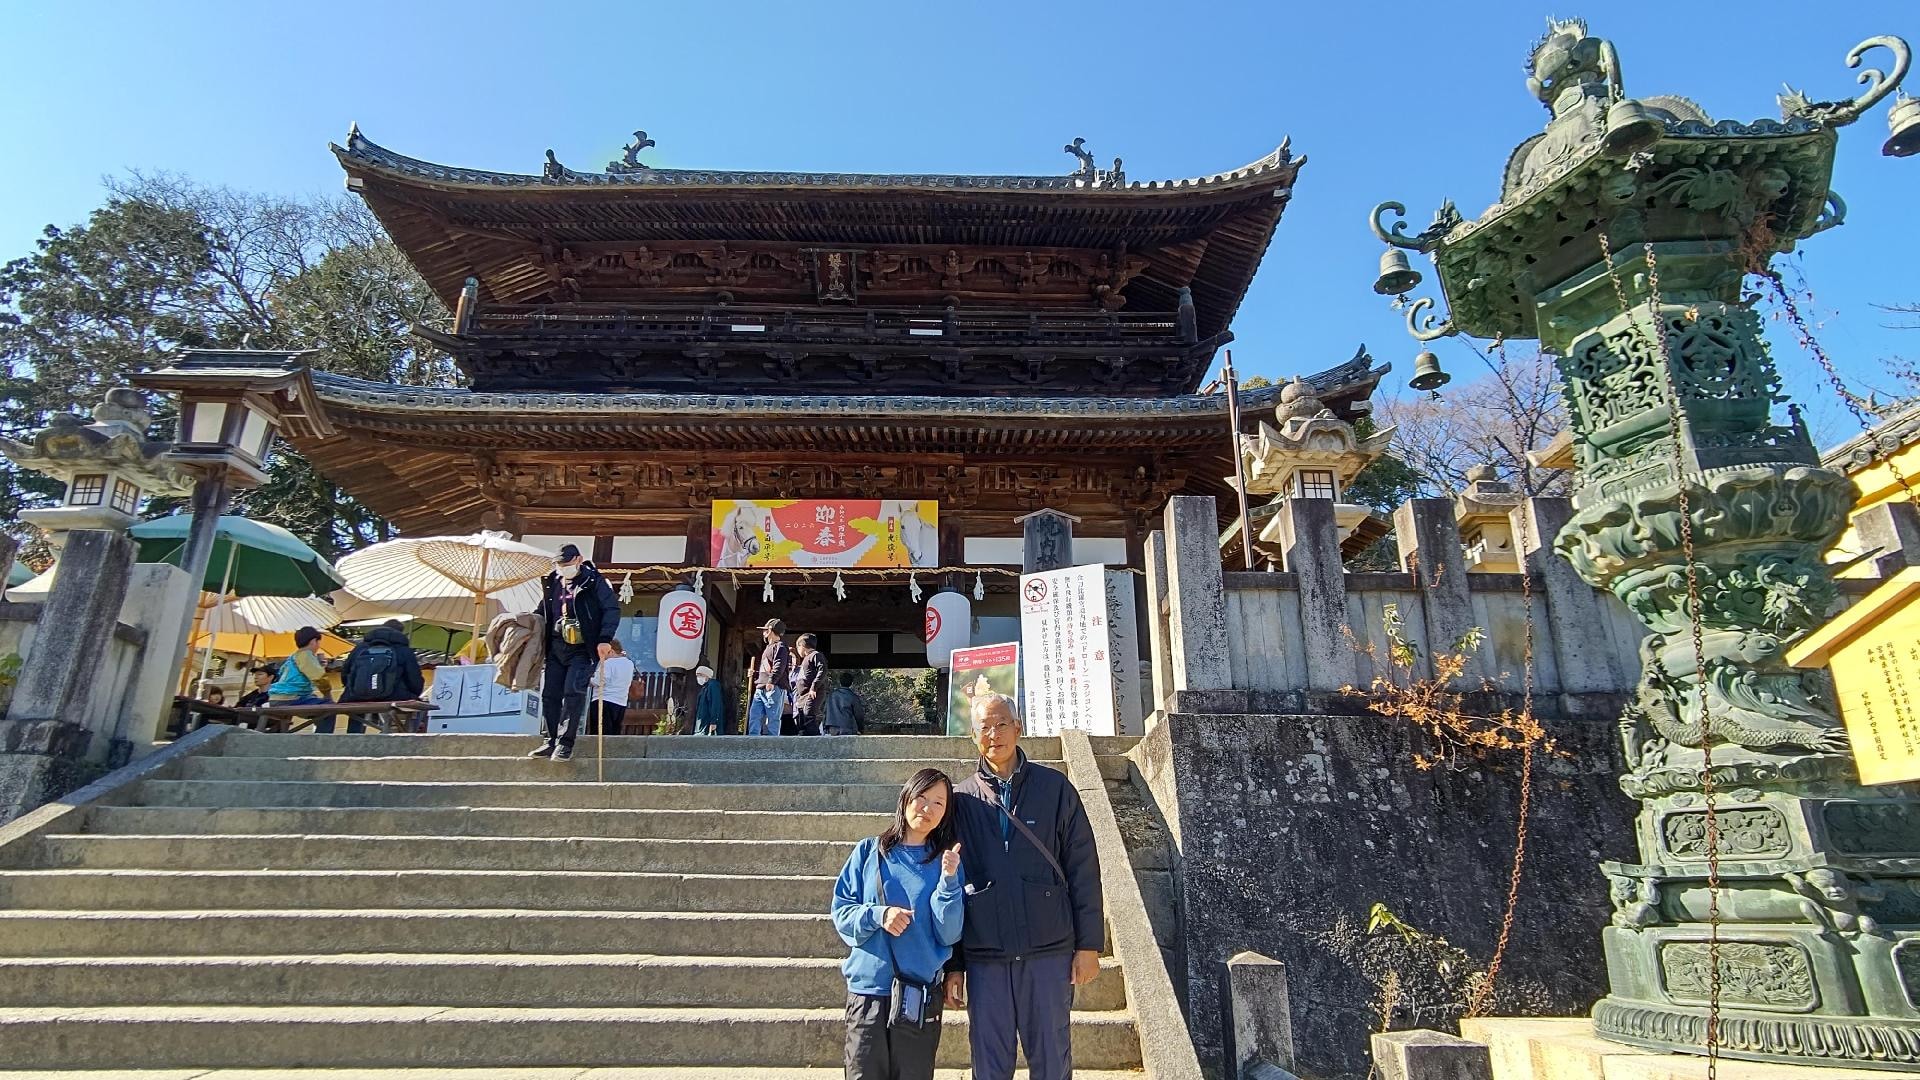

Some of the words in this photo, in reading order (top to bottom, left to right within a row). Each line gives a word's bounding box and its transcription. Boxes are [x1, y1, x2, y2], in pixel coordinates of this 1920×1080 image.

[814, 504, 836, 547] 迎春
[676, 608, 701, 633] 金
[1091, 615, 1105, 661] 注意
